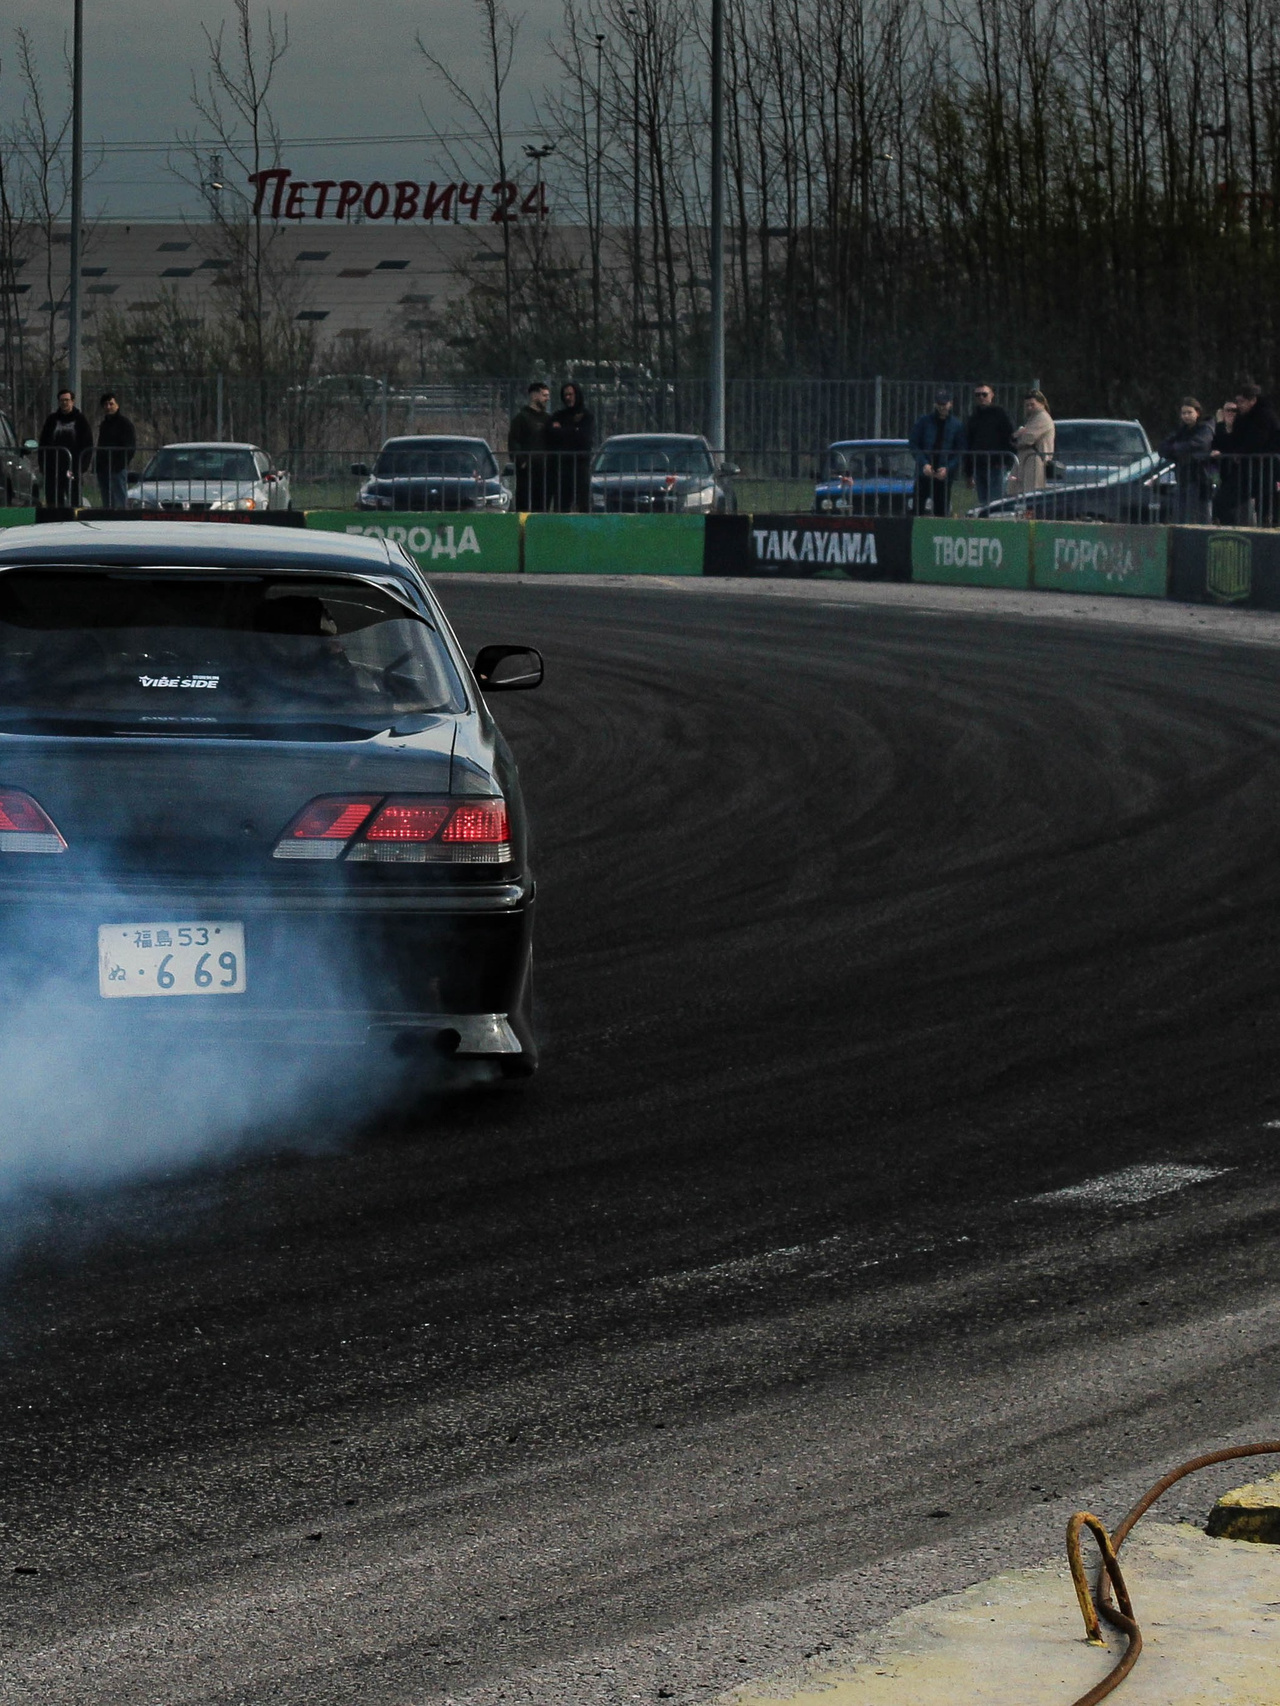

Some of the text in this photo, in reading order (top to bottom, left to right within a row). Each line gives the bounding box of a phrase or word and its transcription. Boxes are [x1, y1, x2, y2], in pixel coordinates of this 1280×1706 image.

[346, 525, 481, 559] РОДА
[753, 530, 878, 564] TAKAYAMA
[933, 536, 1003, 568] ТВОЕГО
[180, 679, 219, 689] SIDE
